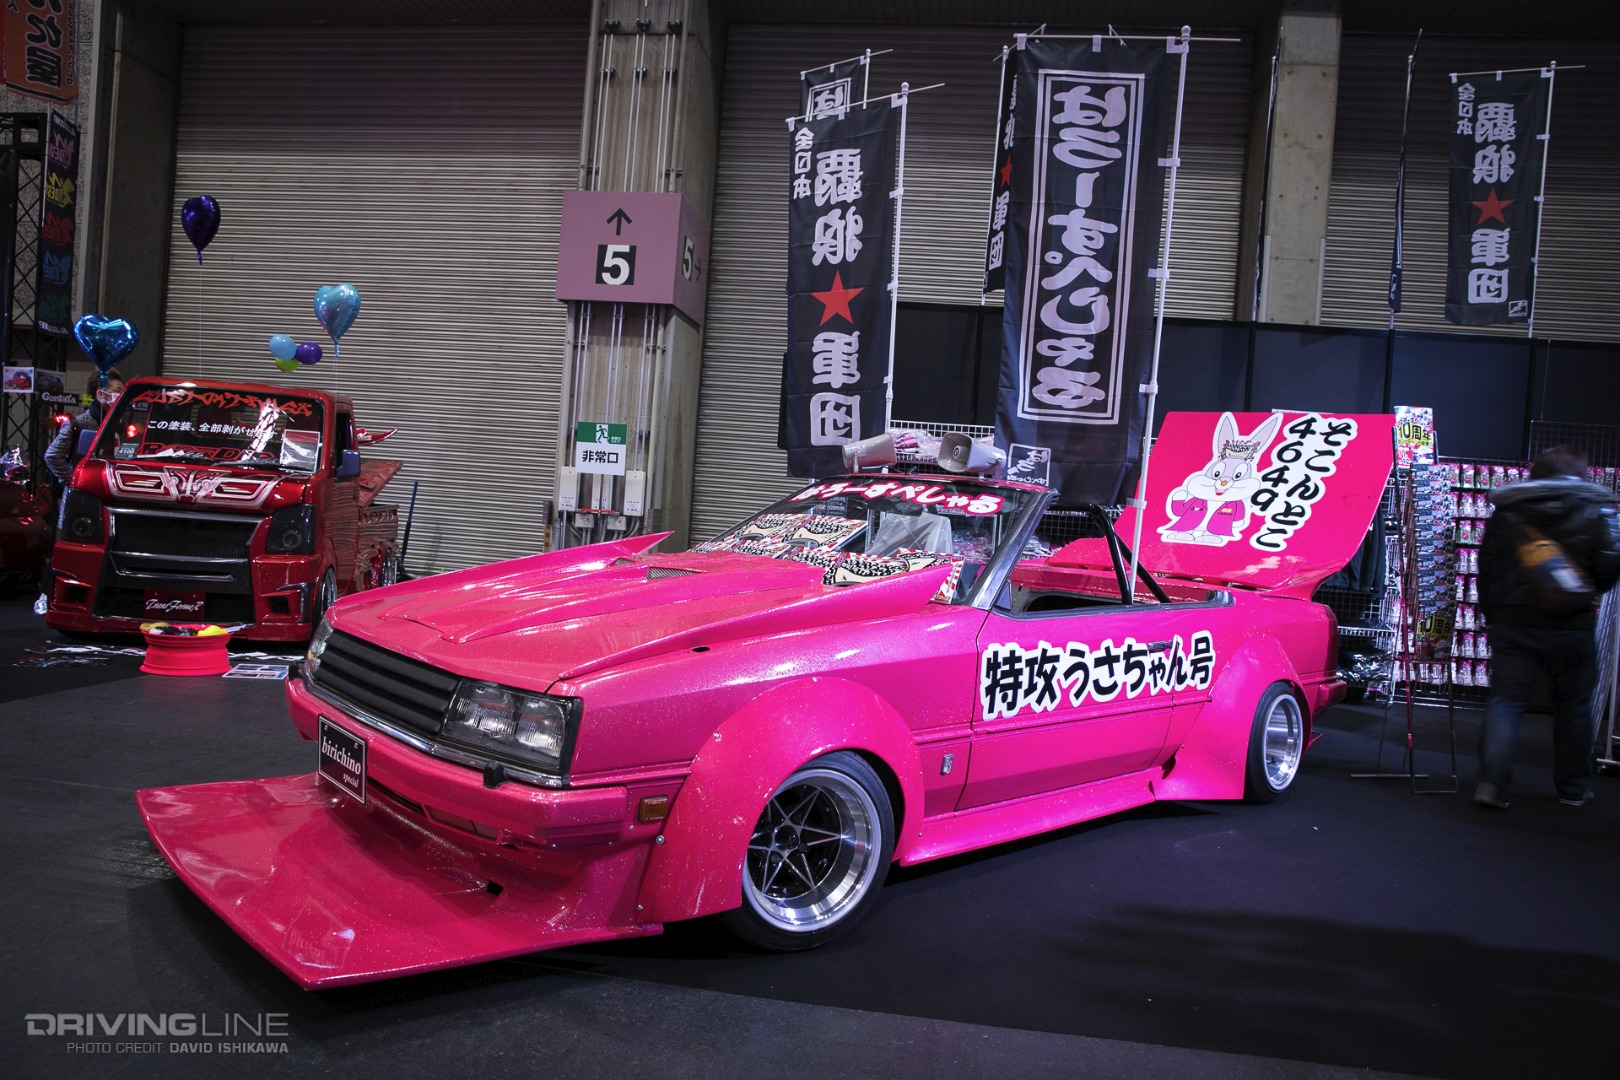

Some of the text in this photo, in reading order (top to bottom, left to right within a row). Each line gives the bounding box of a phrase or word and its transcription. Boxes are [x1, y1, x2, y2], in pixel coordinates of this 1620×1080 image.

[601, 244, 630, 285] 5
[682, 235, 695, 281] 5
[582, 449, 619, 464] 非常口
[1250, 416, 1318, 512] 4649
[789, 481, 1003, 515] はろーすぺしゃる
[1256, 421, 1352, 549] そこんとこ
[985, 635, 1214, 715] 特攻うさちゃん号
[321, 736, 362, 775] birichino
[342, 773, 359, 788] special
